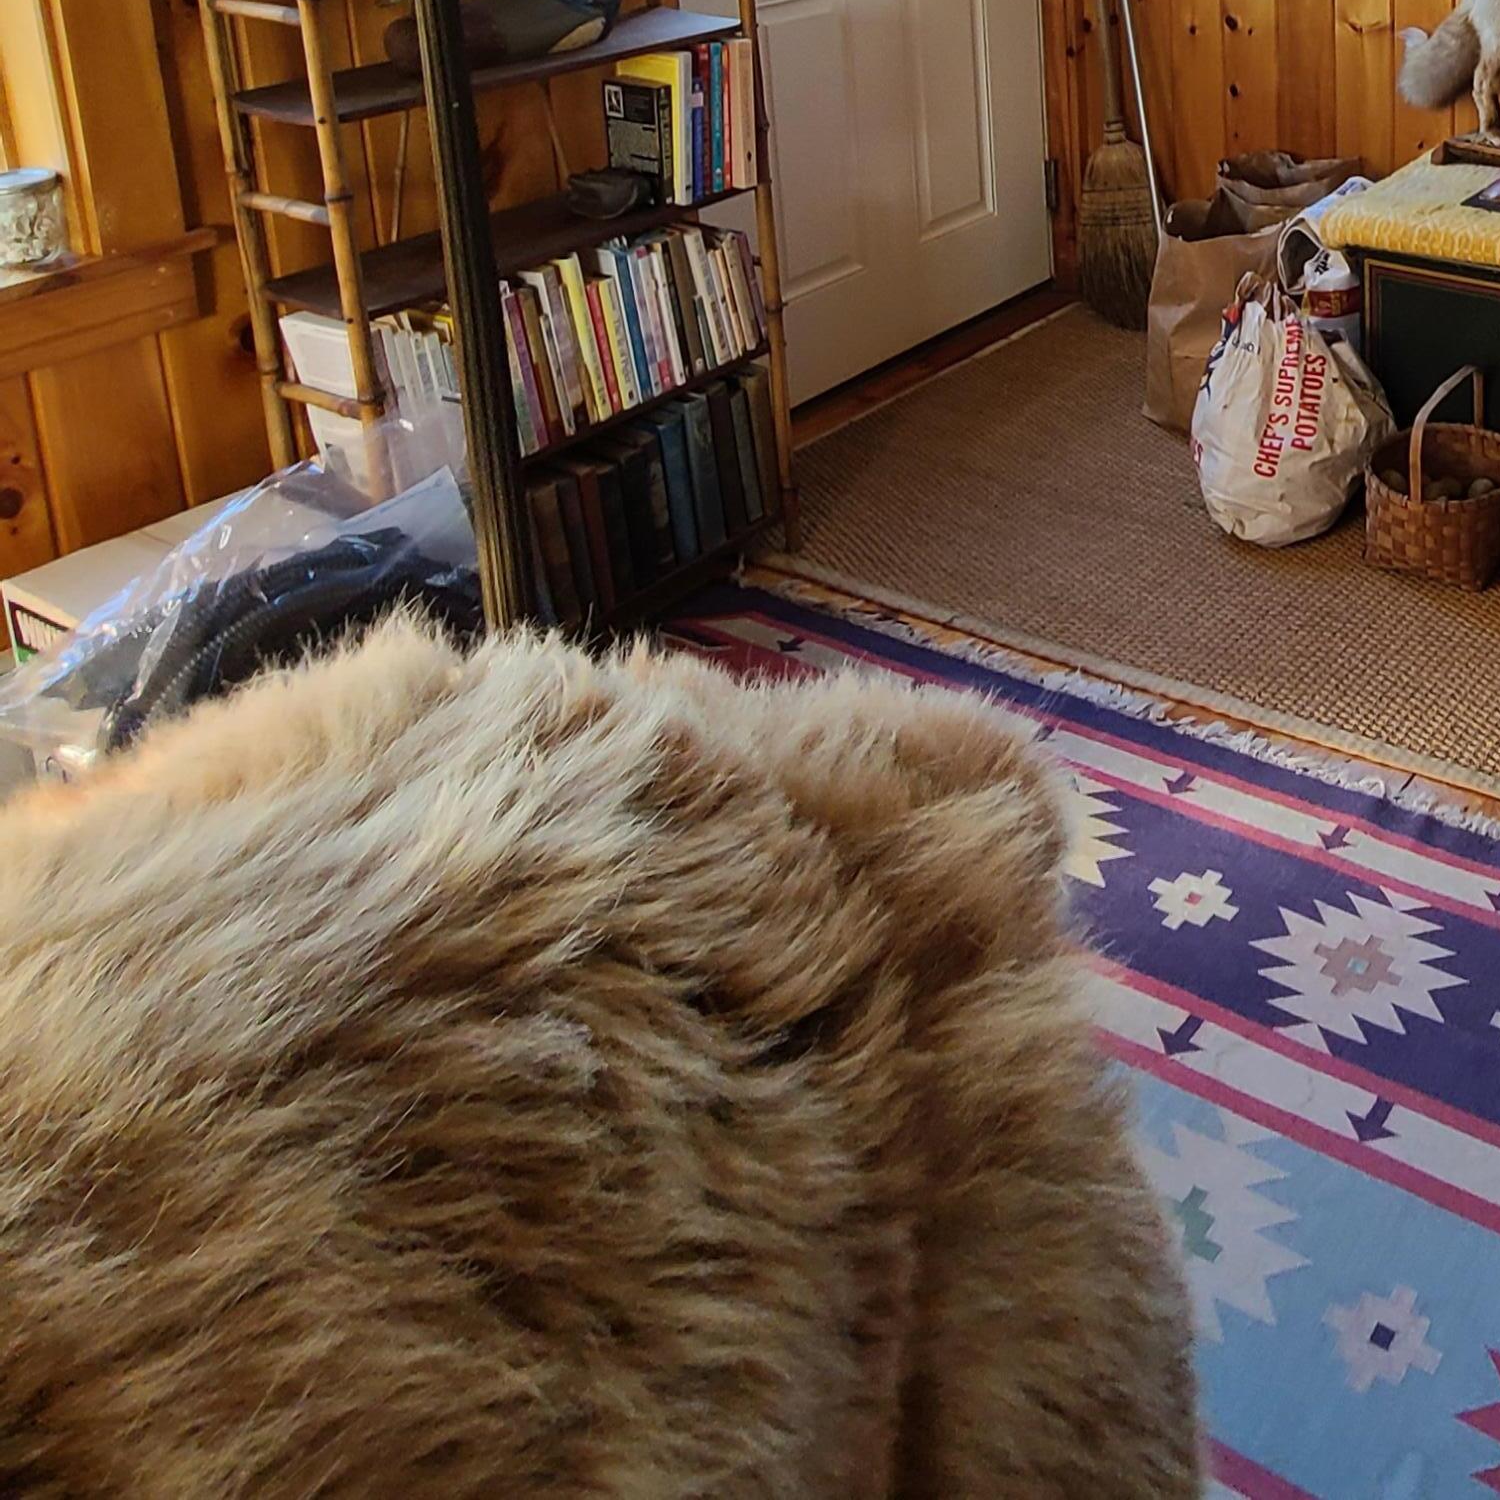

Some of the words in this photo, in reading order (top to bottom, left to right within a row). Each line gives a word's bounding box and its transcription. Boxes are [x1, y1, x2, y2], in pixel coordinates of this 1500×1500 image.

[1252, 411, 1289, 480] CHEF'S
[1274, 318, 1304, 408] SUPREME
[1290, 353, 1328, 452] POTATOES
